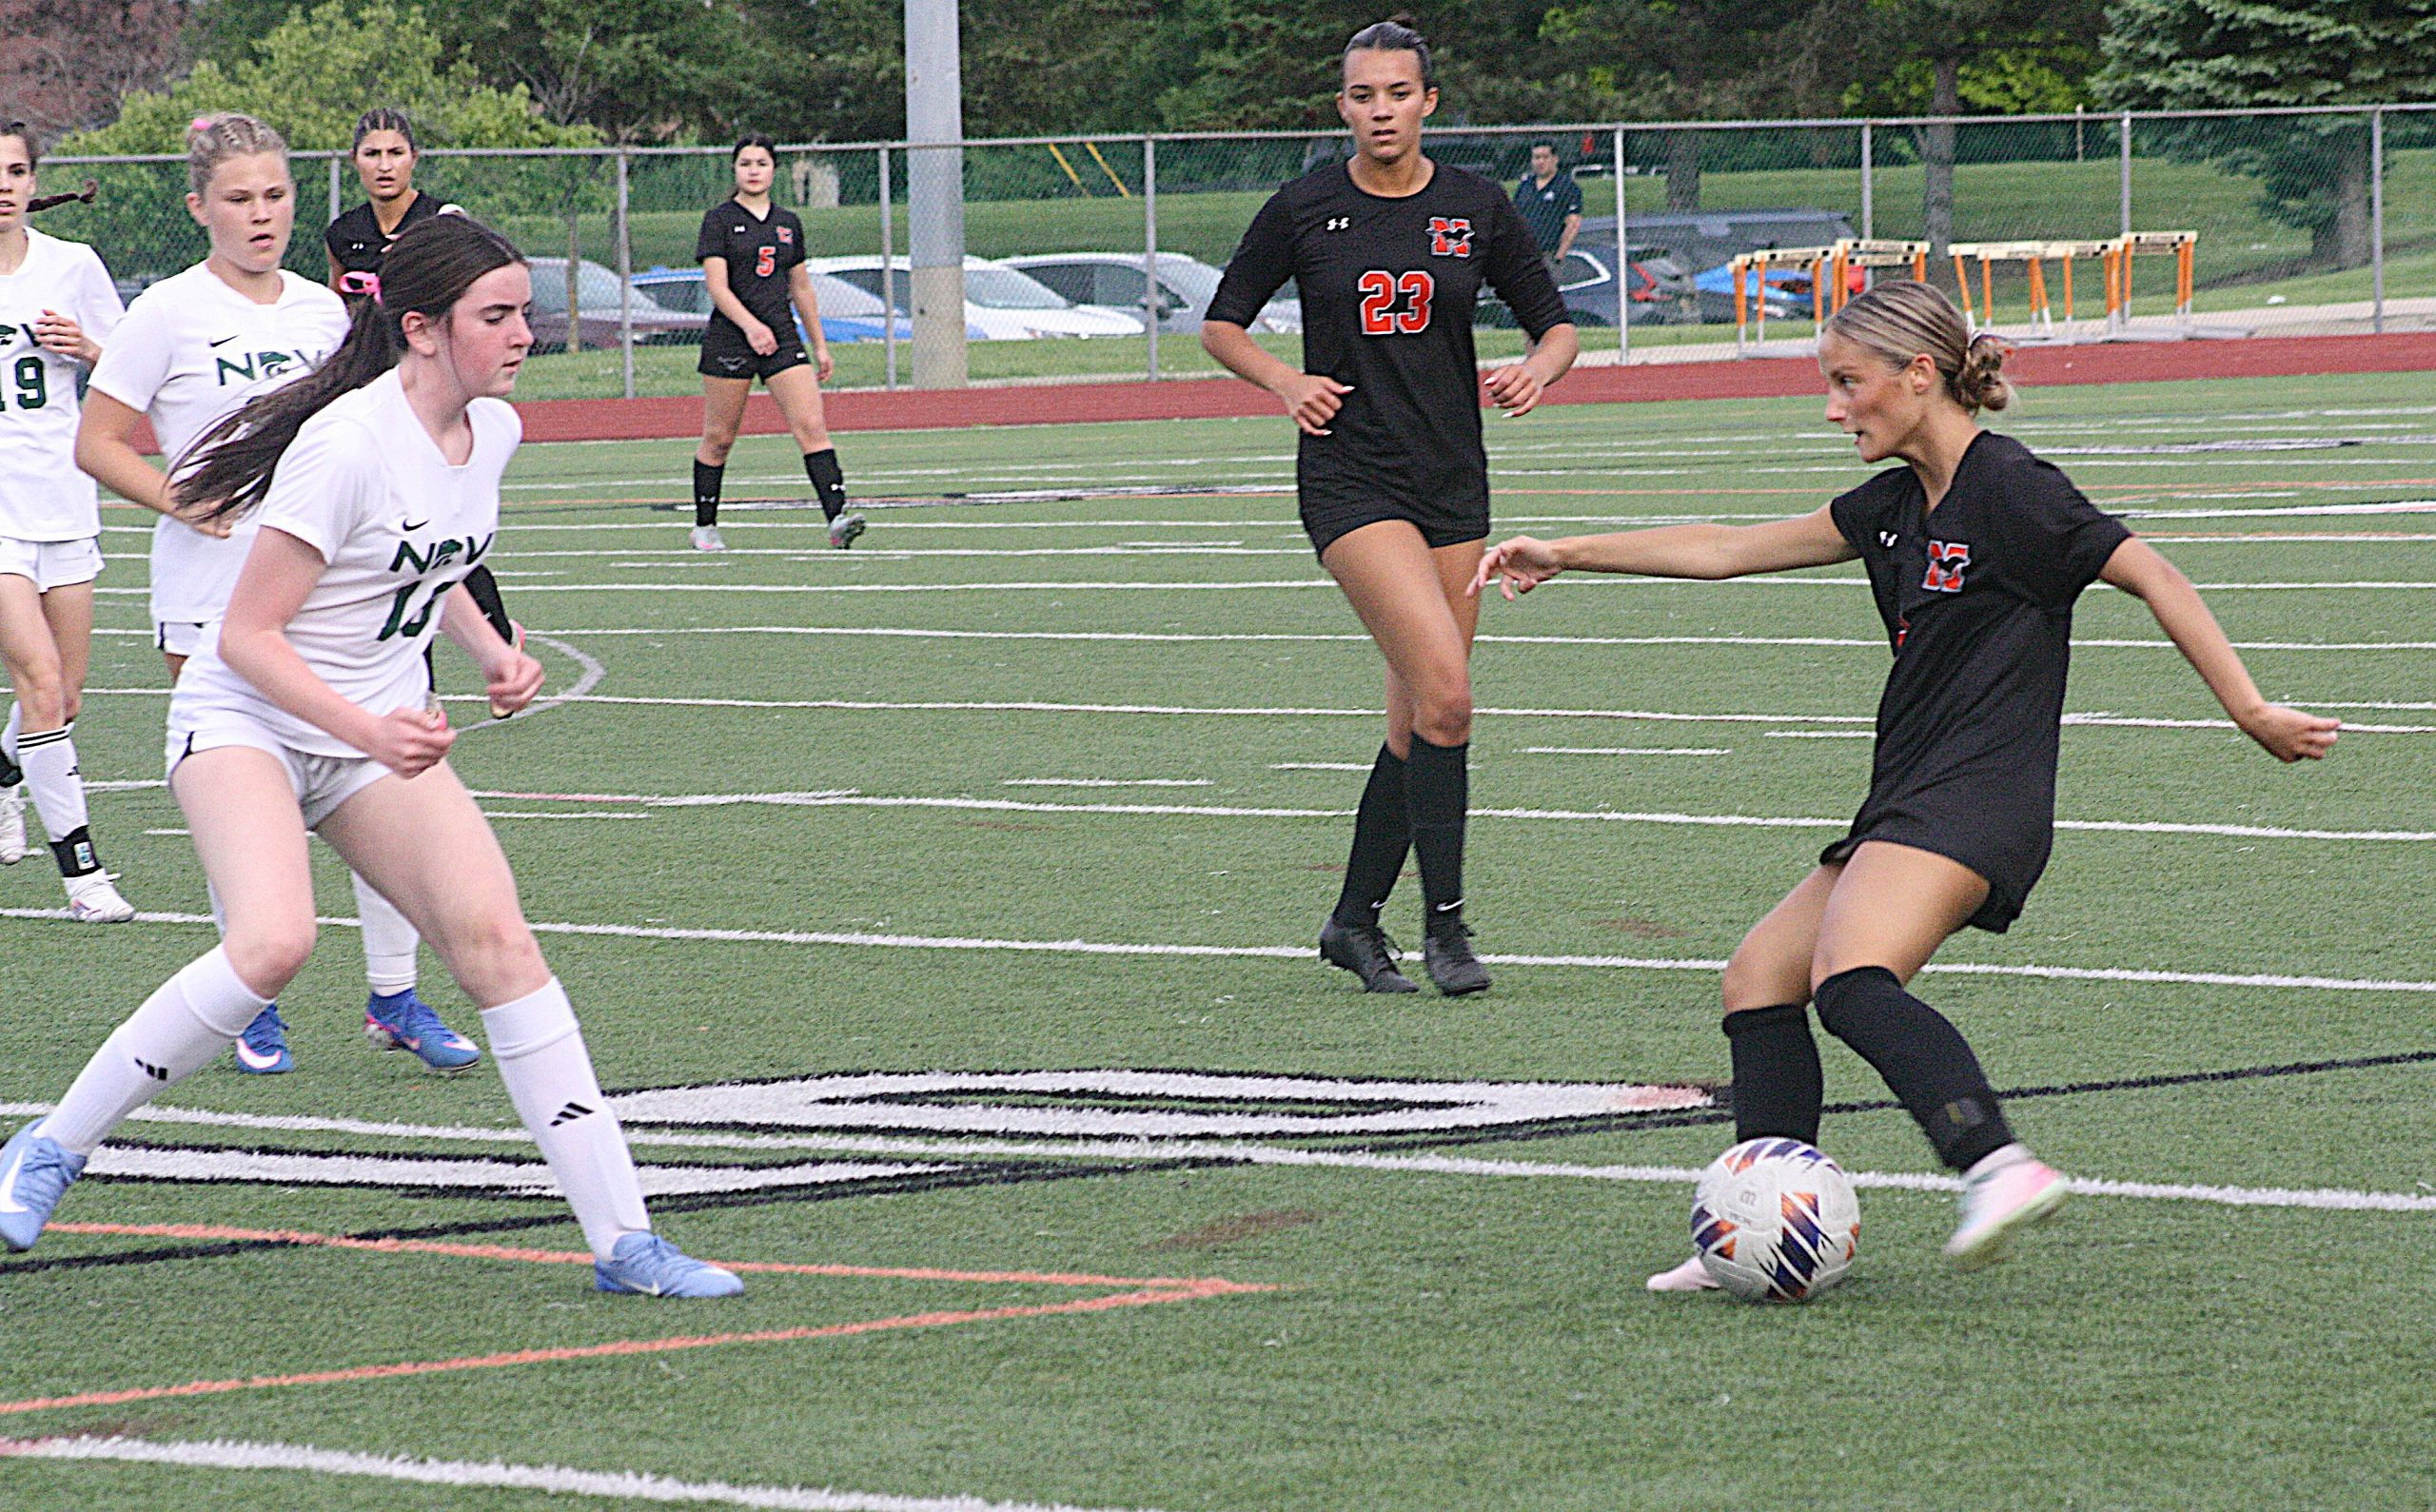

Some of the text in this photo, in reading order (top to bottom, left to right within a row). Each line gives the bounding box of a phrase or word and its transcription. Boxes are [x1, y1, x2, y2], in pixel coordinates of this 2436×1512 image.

[756, 246, 776, 277] 5
[1358, 270, 1435, 335] 23
[0, 356, 47, 412] 9
